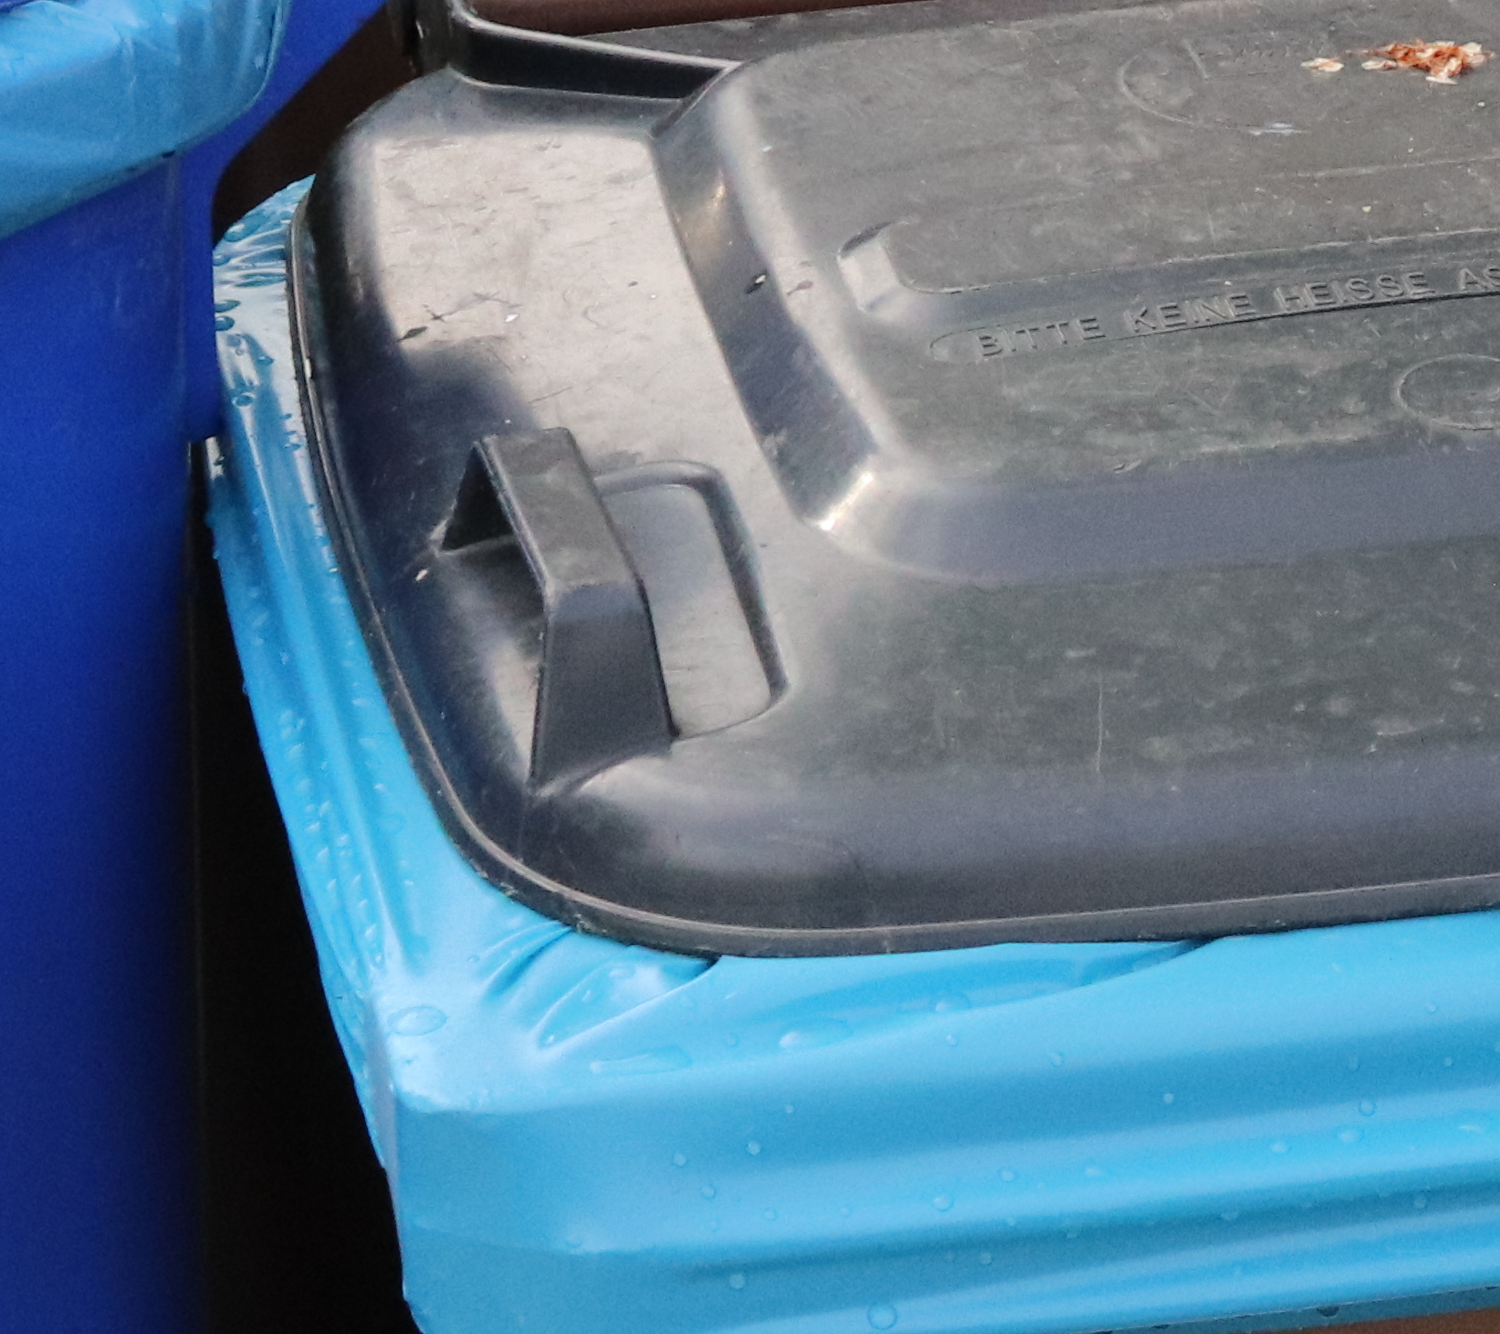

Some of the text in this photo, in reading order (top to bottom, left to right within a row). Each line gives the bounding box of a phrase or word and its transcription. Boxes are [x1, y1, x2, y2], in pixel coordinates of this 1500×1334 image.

[977, 315, 1105, 358] BITTE
[1123, 290, 1257, 334] KEINE
[1274, 271, 1436, 311] HEISSE
